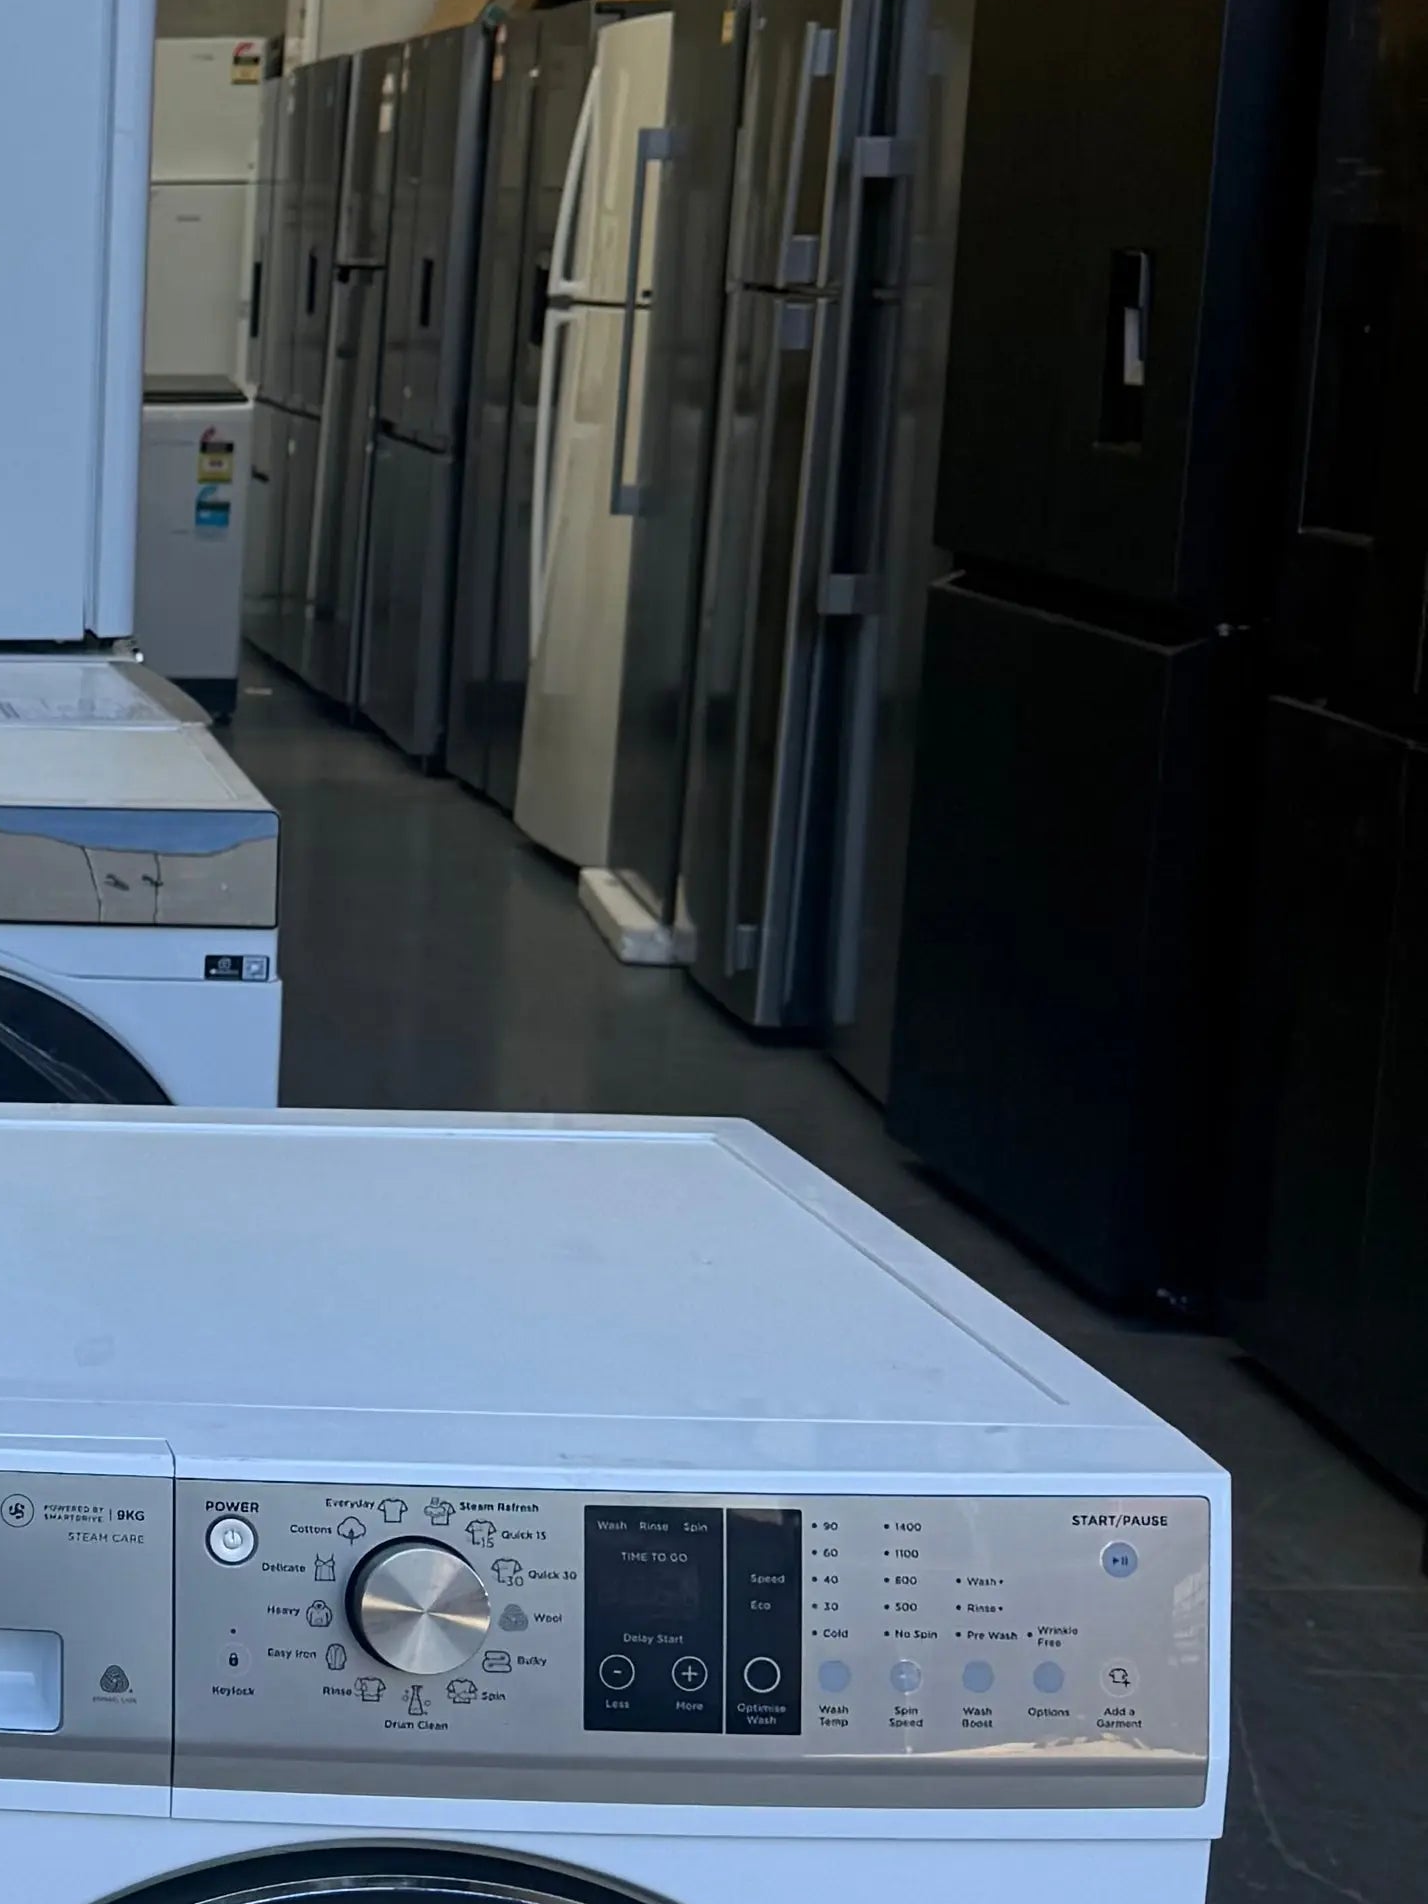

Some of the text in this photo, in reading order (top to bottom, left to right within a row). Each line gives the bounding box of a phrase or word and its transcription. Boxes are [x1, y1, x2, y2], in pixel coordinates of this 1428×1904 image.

[206, 1501, 259, 1512] POWER
[326, 1498, 375, 1510] Everyday
[460, 1502, 539, 1512] Steam Refresh
[117, 1510, 144, 1521] 9KG
[597, 1520, 627, 1530] Wash
[1072, 1515, 1168, 1527] START/PAUSE
[290, 1525, 332, 1534] Cottons
[640, 1521, 669, 1532] Rinse
[683, 1522, 708, 1532] Spin
[895, 1522, 922, 1532] 1400
[68, 1532, 144, 1544] STEAM CARE
[501, 1530, 546, 1540] Quick 15
[621, 1552, 688, 1562] TIME TO GO
[823, 1549, 838, 1557] 60
[895, 1549, 919, 1558] 1100
[262, 1563, 306, 1573] Delicate
[528, 1570, 577, 1580] Quick 30
[751, 1574, 785, 1584] Speed
[823, 1576, 838, 1584] 40
[751, 1600, 771, 1610] Eco
[824, 1602, 839, 1611] 30
[895, 1603, 917, 1612] 500
[267, 1605, 301, 1616] Heavy
[534, 1614, 562, 1623] Wool
[823, 1629, 848, 1638] Cold
[895, 1630, 938, 1639] No Spin
[967, 1631, 1018, 1640] Pre Wash
[1038, 1626, 1078, 1635] Wrinkle
[624, 1633, 683, 1645] Delay Start
[1038, 1638, 1061, 1647] Free
[268, 1648, 316, 1659] Easy Iron
[212, 1685, 255, 1696] Keylock
[323, 1686, 352, 1696] Rinse
[606, 1700, 629, 1708] Less
[676, 1701, 703, 1710] More
[737, 1703, 786, 1713] Optimise
[819, 1705, 849, 1714] Wash
[895, 1706, 918, 1716] Spin
[963, 1707, 992, 1716] Wash
[1028, 1707, 1070, 1717] Options
[1104, 1708, 1126, 1716] Add
[385, 1720, 448, 1730] Drum Clean
[747, 1716, 777, 1725] Wash
[819, 1717, 848, 1728] Temp
[889, 1718, 923, 1728] Speed
[962, 1719, 993, 1728] Boost
[1097, 1719, 1142, 1728] Garment
